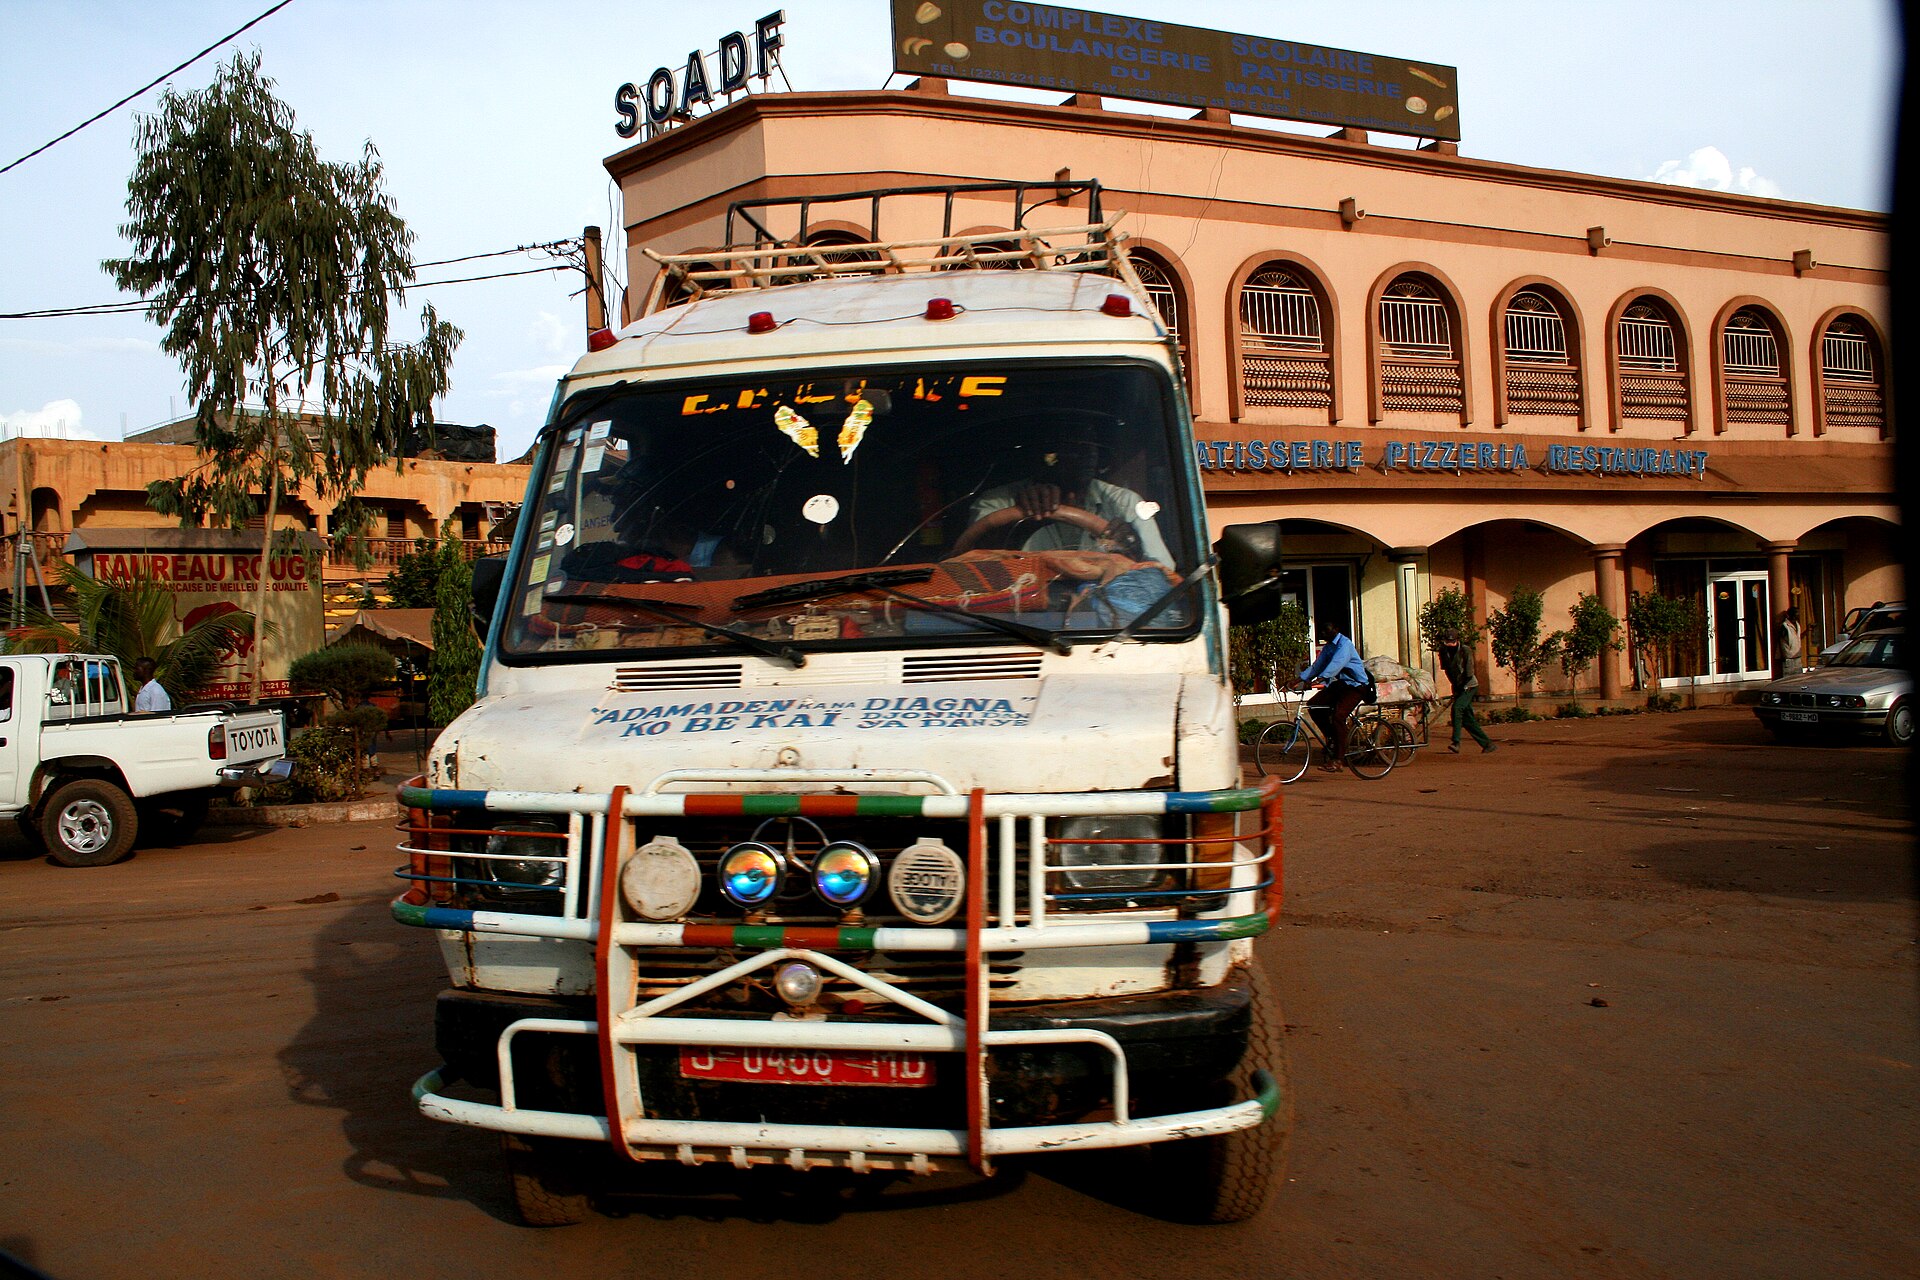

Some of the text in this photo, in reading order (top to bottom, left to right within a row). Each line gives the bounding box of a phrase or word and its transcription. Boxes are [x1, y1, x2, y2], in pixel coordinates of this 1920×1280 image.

[982, 0, 1375, 74] COMPLEXE SCOLAIRE
[615, 9, 786, 138] SOADF
[975, 26, 1403, 99] BOULANGERIE PATISSERIE
[931, 63, 958, 75] TEL
[1093, 81, 1118, 93] FAX
[1110, 65, 1292, 99] DU MALI
[1386, 440, 1531, 470] PIZZERIA
[1548, 443, 1710, 473] RESTAURANT
[96, 554, 318, 582] TAUREAU ROUG
[205, 582, 218, 592] DE
[219, 582, 271, 592] MEILLEUE
[271, 582, 309, 592] QUALITE
[223, 684, 239, 692] FAX
[266, 681, 280, 689] 221
[797, 702, 856, 710] KANA
[231, 728, 279, 752] TOYOTA
[619, 721, 672, 737] KO
[680, 716, 740, 732] BE
